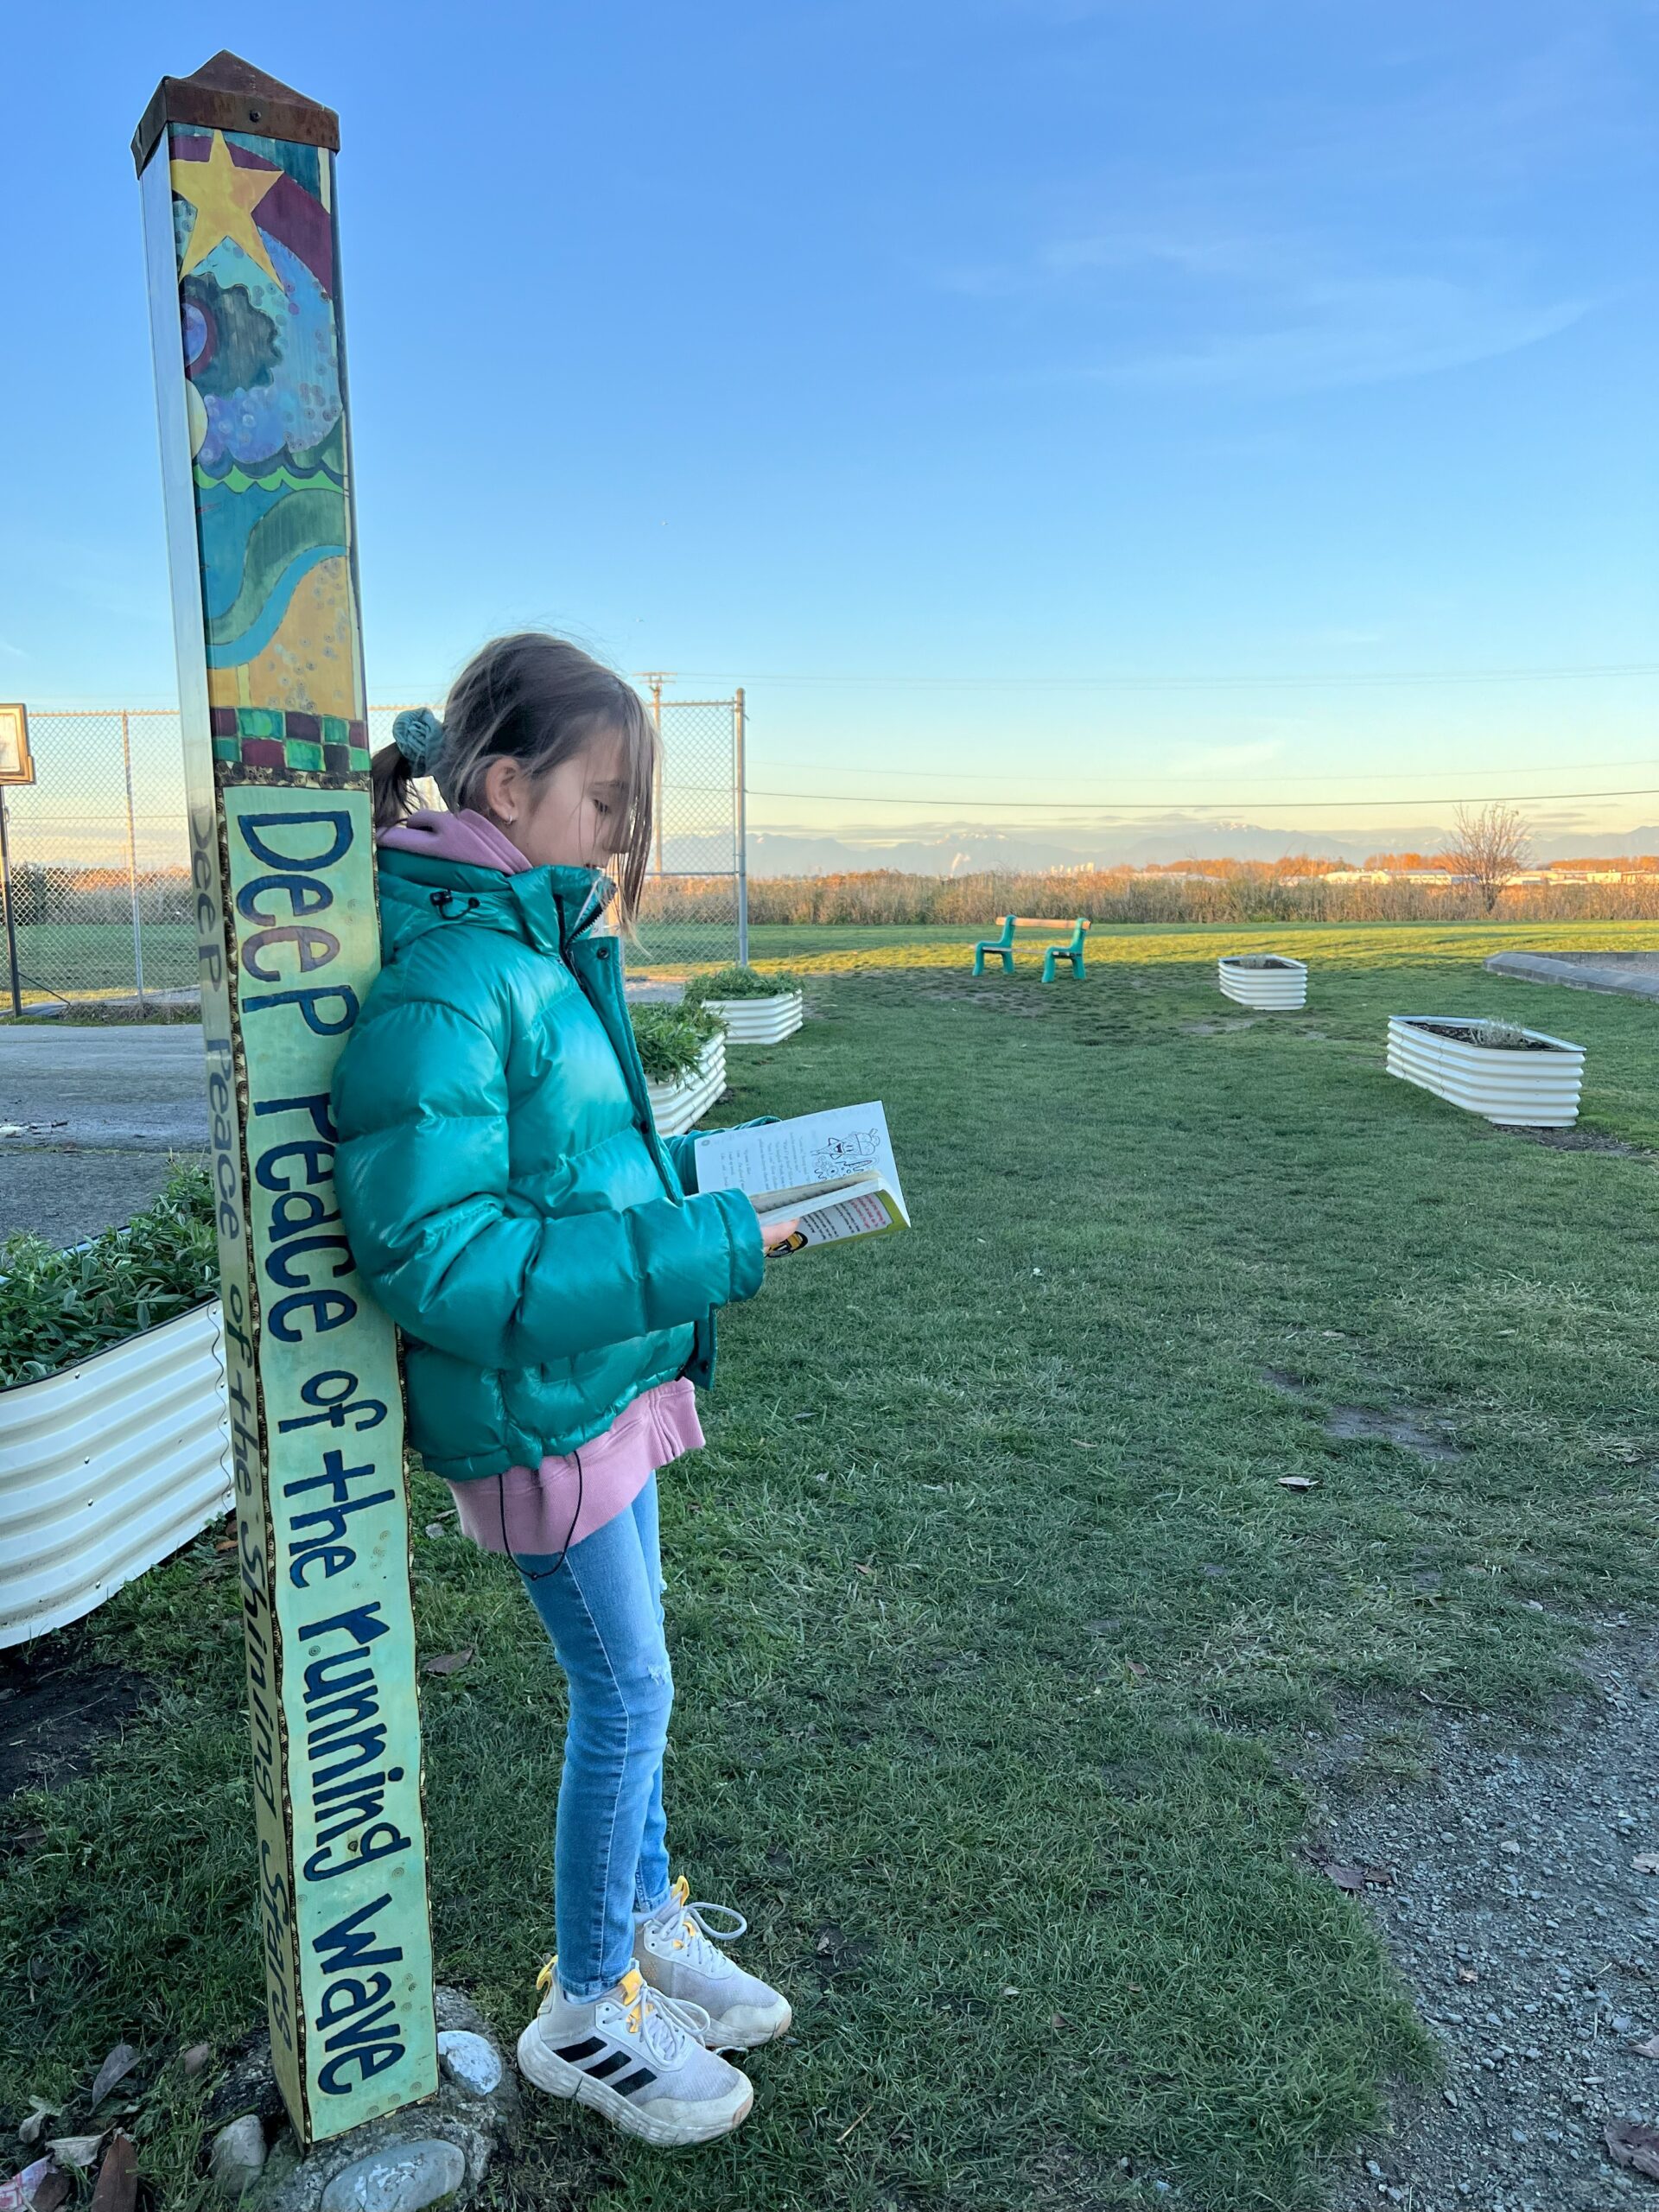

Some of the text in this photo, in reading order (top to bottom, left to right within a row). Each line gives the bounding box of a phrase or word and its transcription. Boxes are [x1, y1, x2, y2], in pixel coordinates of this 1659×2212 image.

[207, 1039, 239, 1241] Peace
[226, 1284, 254, 1369] of
[278, 1370, 387, 1433] of
[230, 1370, 258, 1497] the
[283, 1449, 395, 1589] the
[241, 1520, 276, 1820] Shining
[298, 1601, 411, 1882] running
[261, 1839, 292, 2052] Stars
